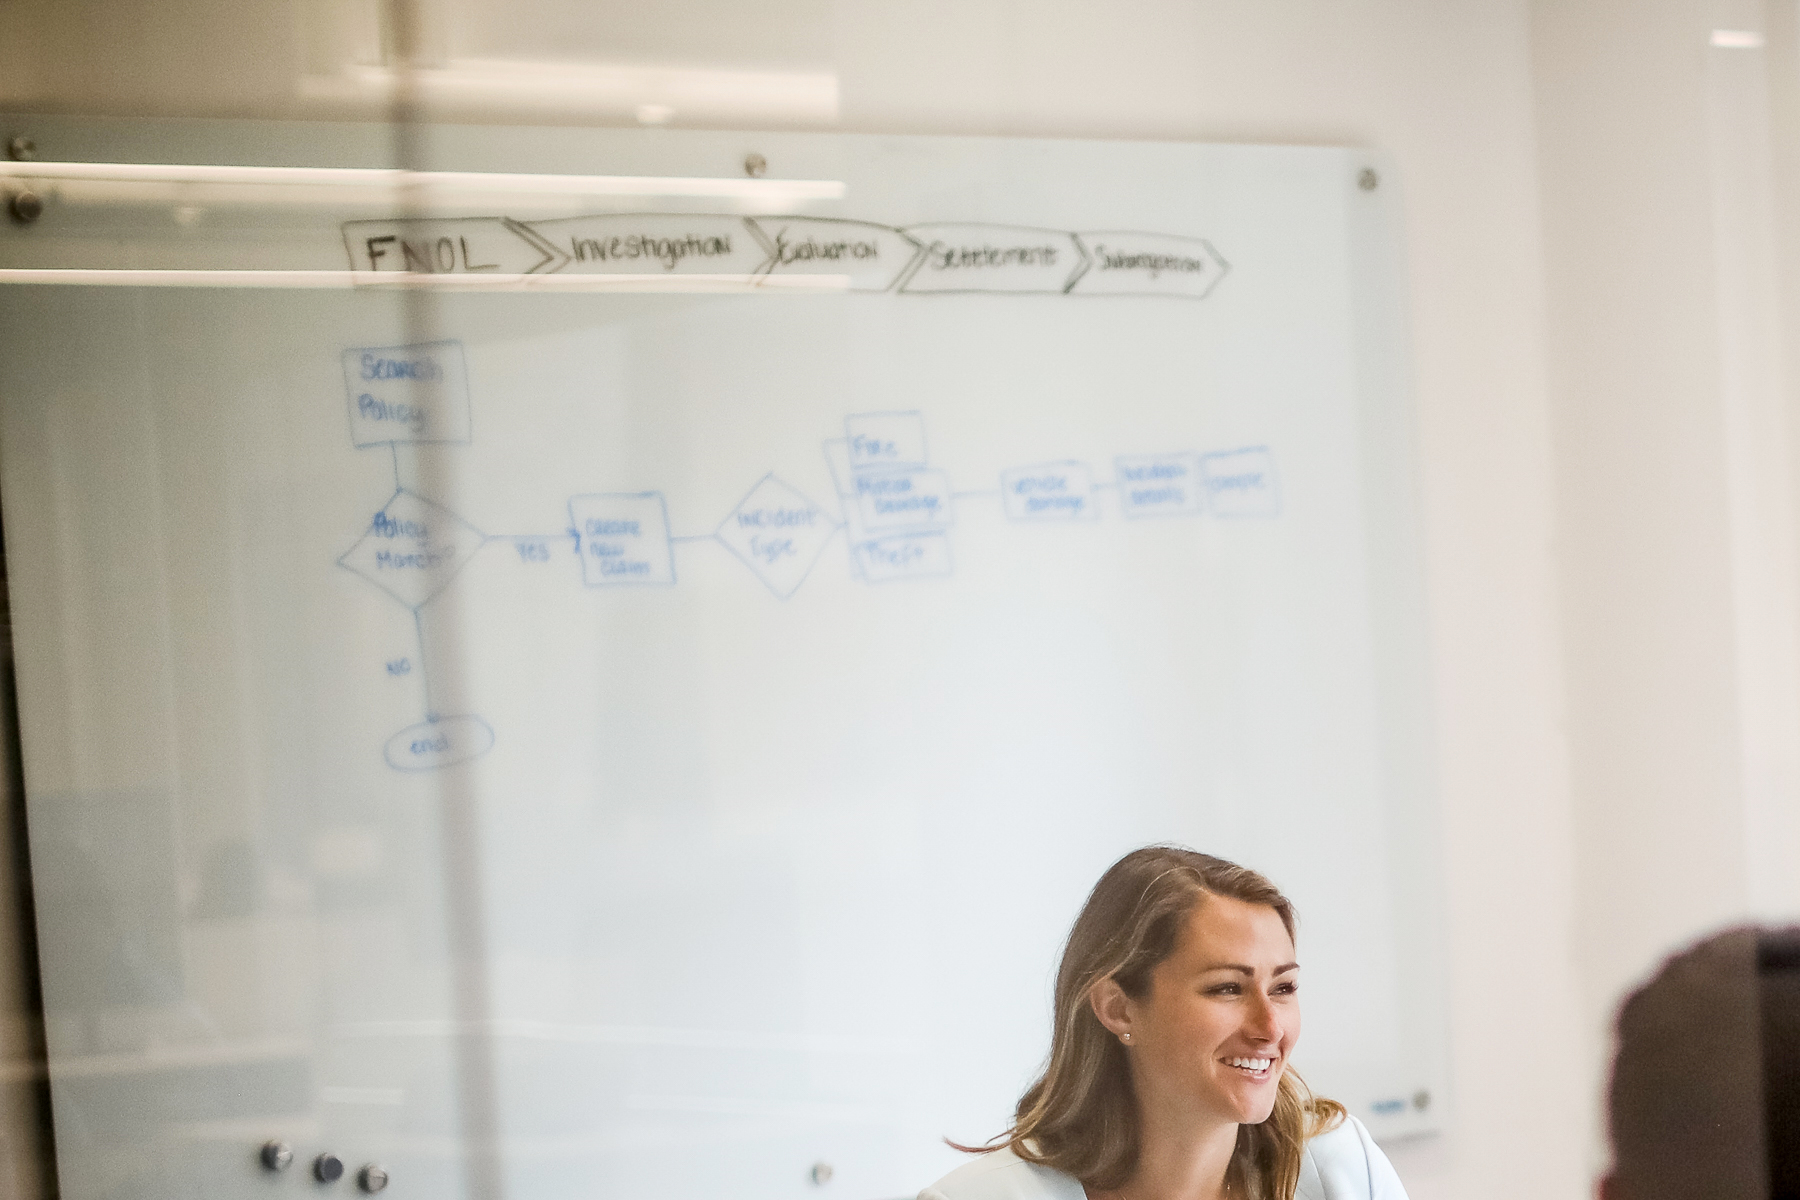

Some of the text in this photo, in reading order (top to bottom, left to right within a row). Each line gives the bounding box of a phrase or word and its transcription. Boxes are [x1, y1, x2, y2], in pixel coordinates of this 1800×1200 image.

[366, 235, 501, 273] FNOL
[571, 234, 732, 269] Investigation
[358, 393, 429, 435] Policy
